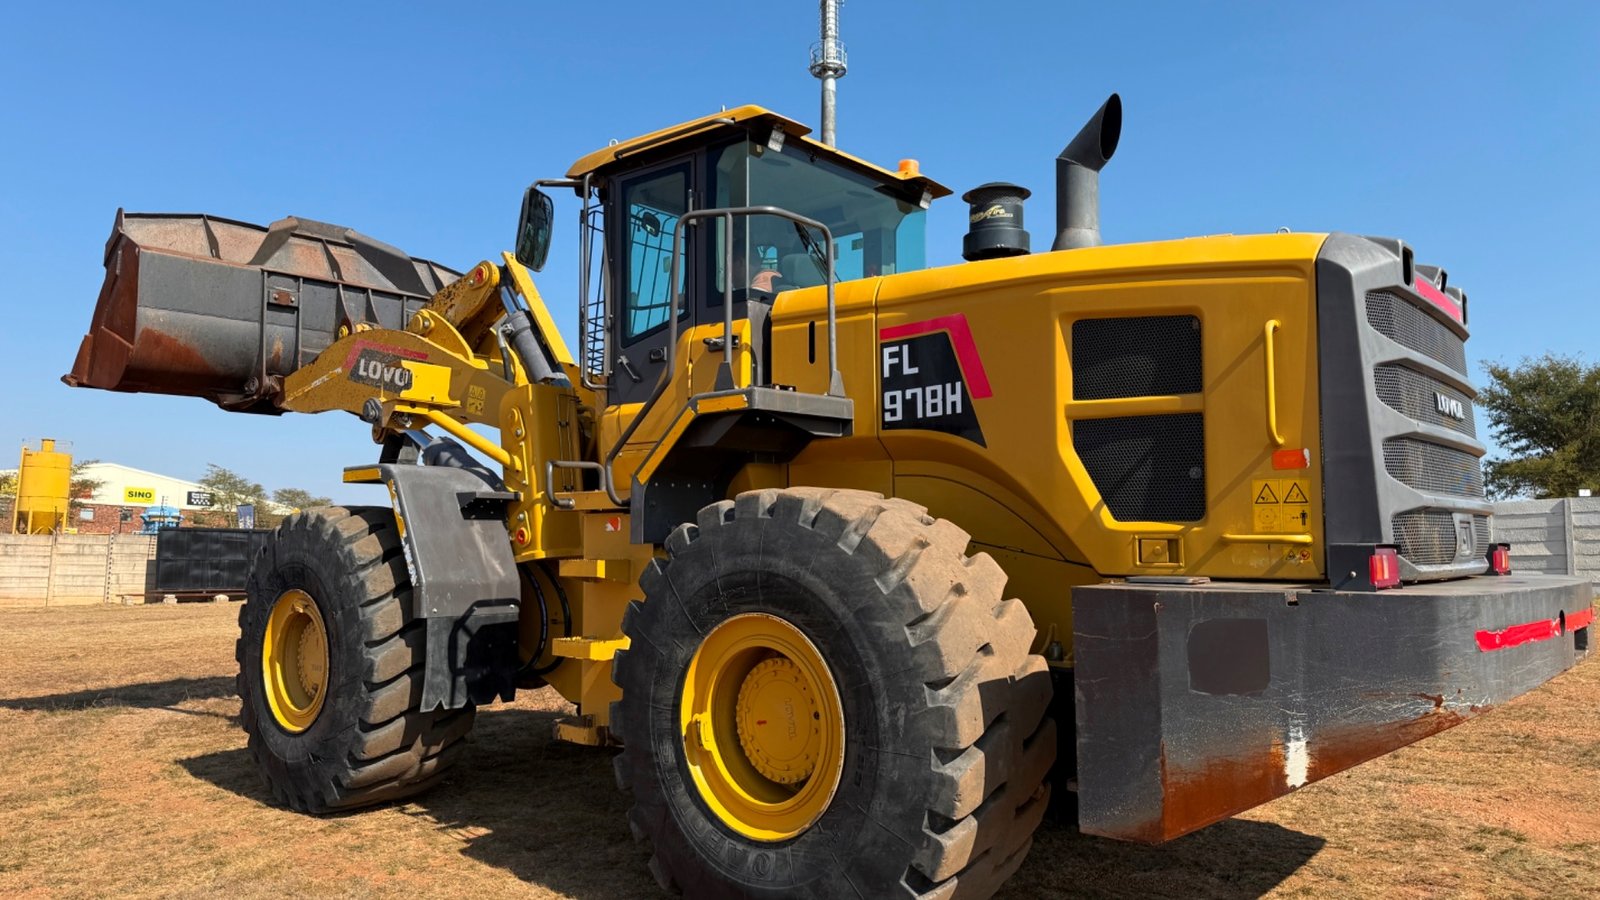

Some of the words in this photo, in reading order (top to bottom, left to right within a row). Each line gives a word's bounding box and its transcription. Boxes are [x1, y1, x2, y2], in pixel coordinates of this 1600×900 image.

[358, 358, 411, 387] LOVO
[883, 344, 919, 378] FL
[884, 381, 962, 422] 978H
[128, 490, 152, 499] SINO
